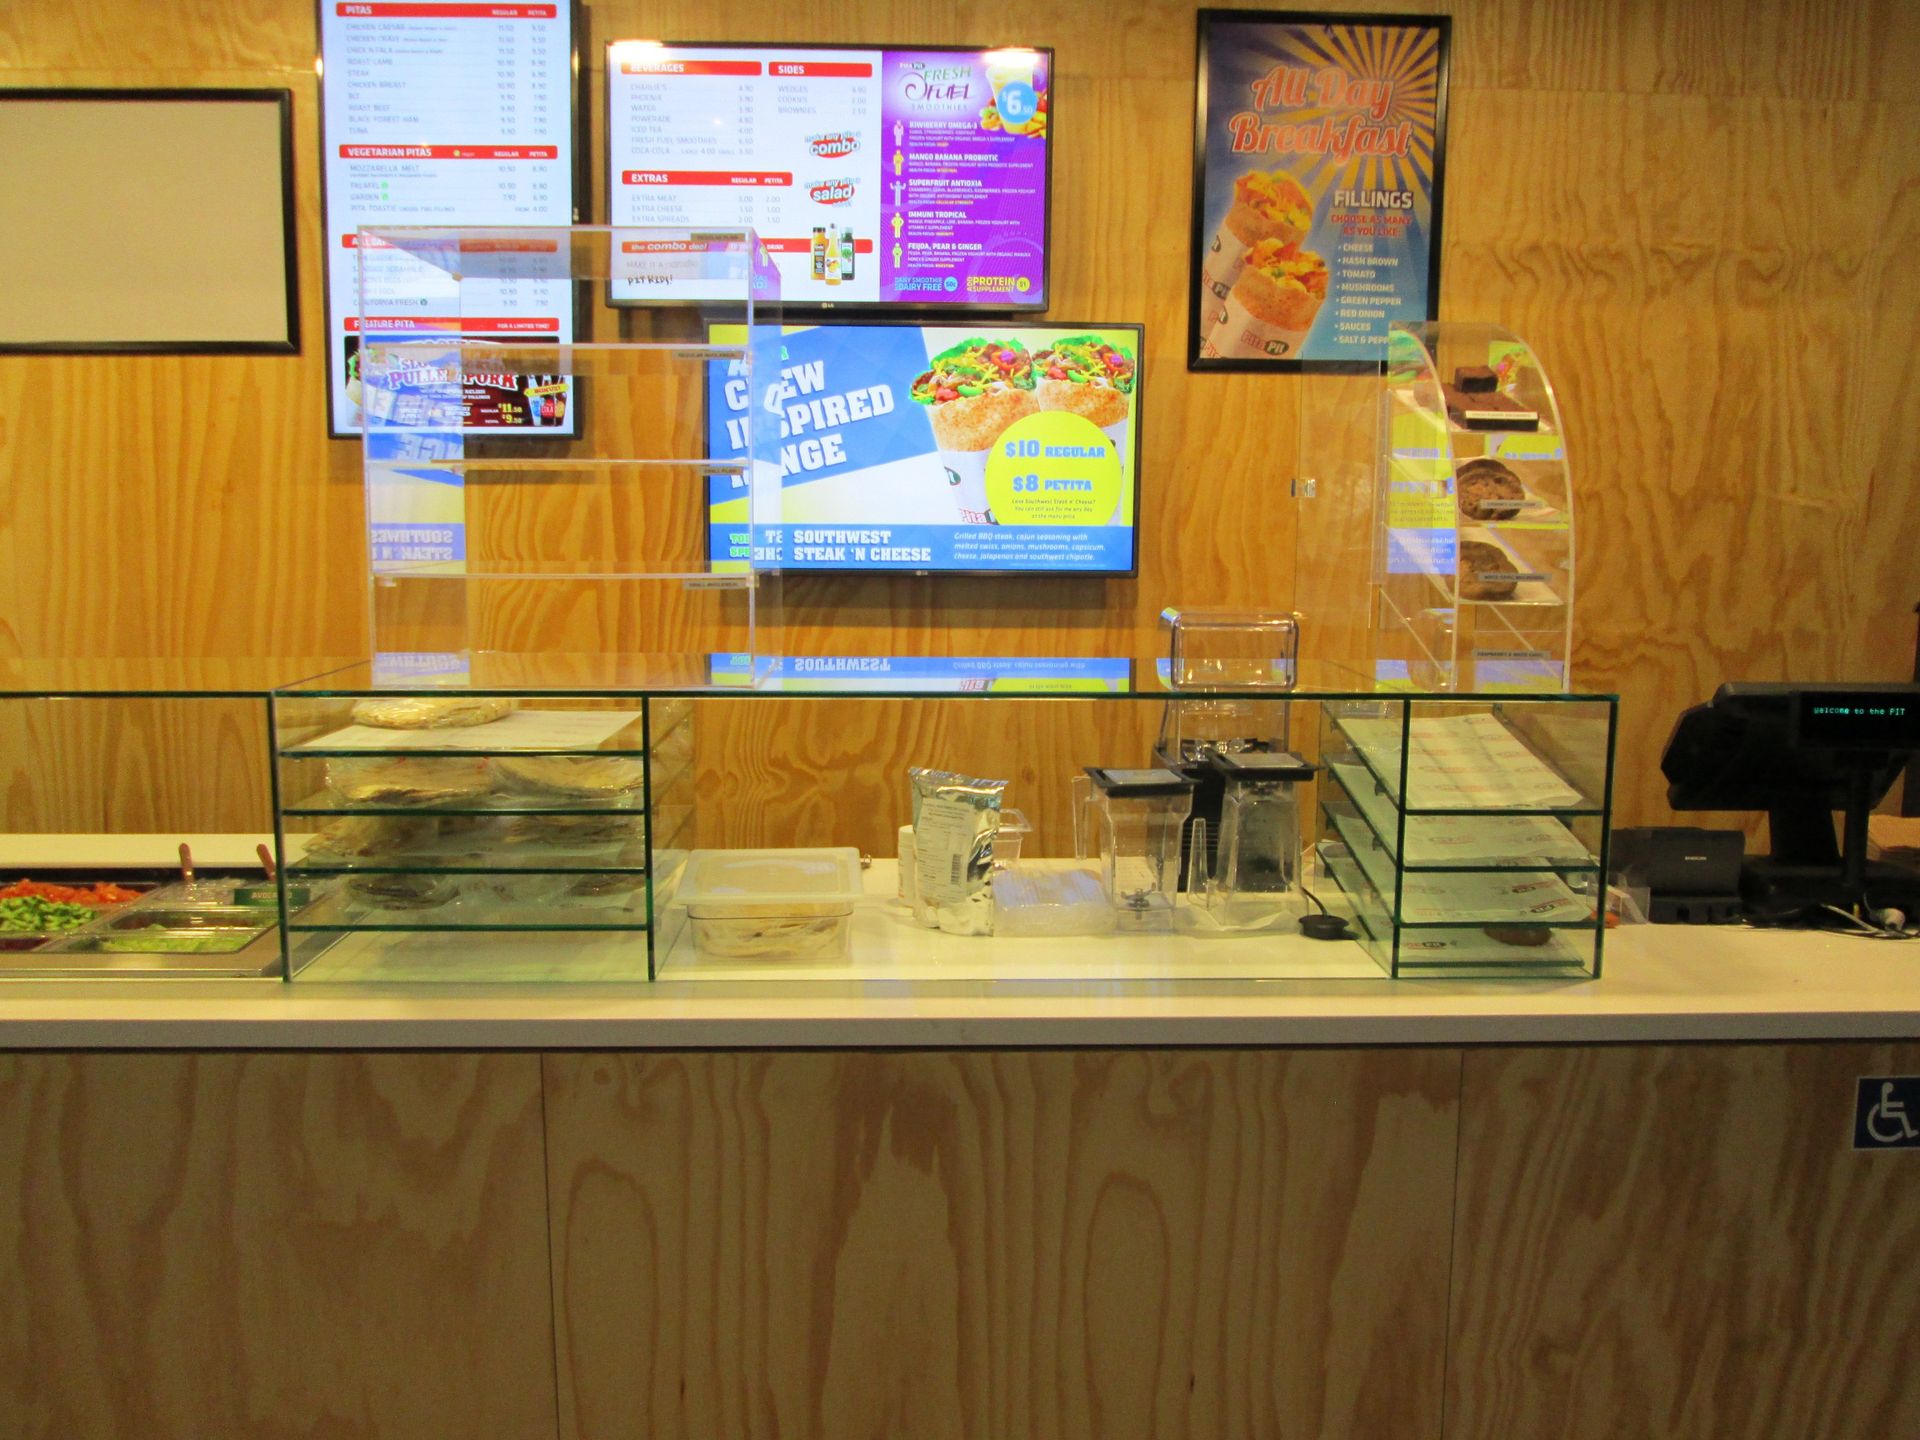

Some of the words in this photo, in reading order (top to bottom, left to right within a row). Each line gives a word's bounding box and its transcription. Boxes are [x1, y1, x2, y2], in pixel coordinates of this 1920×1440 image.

[346, 5, 372, 15] PITAS
[630, 64, 684, 72] BEVERAGES
[778, 65, 804, 74] SIDES
[924, 66, 972, 81] FRESH
[1251, 65, 1311, 112] All
[1314, 65, 1395, 121] Day
[909, 121, 946, 129] KIWIBERRY
[1229, 111, 1413, 167] Breakfast
[348, 148, 404, 157] VEGETARIAN
[406, 148, 432, 156] PITAS
[809, 140, 861, 156] combo
[631, 174, 668, 183] EXTRAS
[813, 184, 853, 201] salad
[1333, 190, 1414, 209] FILLINGS
[1331, 215, 1367, 224] CHOOSE
[1369, 215, 1381, 224] AS
[1383, 215, 1412, 225] MANY
[1357, 227, 1376, 236] YOU
[1343, 243, 1373, 252] CHEESE
[1342, 257, 1364, 265] HASH
[1365, 258, 1398, 266] BROWN
[1342, 270, 1376, 279] TOMATO
[973, 277, 1014, 286] PROTEIN
[1341, 283, 1395, 292] MUSHROOMS
[1340, 296, 1368, 305] GREEN
[1369, 297, 1401, 306] PEPPER
[1340, 310, 1356, 318] RED
[1358, 310, 1385, 319] ONION
[395, 320, 415, 328] PITA
[1339, 323, 1371, 331] SAUCES
[1338, 335, 1358, 344] SALT
[1005, 440, 1040, 458] $10
[1045, 447, 1105, 458] REGULAR
[1013, 474, 1039, 492] $8
[1044, 480, 1092, 491] PETITA
[794, 530, 892, 544] SOUTHWEST
[954, 532, 977, 540] Grilled
[1016, 533, 1035, 541] cajun
[794, 548, 845, 561] STEAK
[870, 548, 931, 561] CHEESE
[1814, 707, 1849, 715] Welcome
[1889, 708, 1906, 716] PIT
